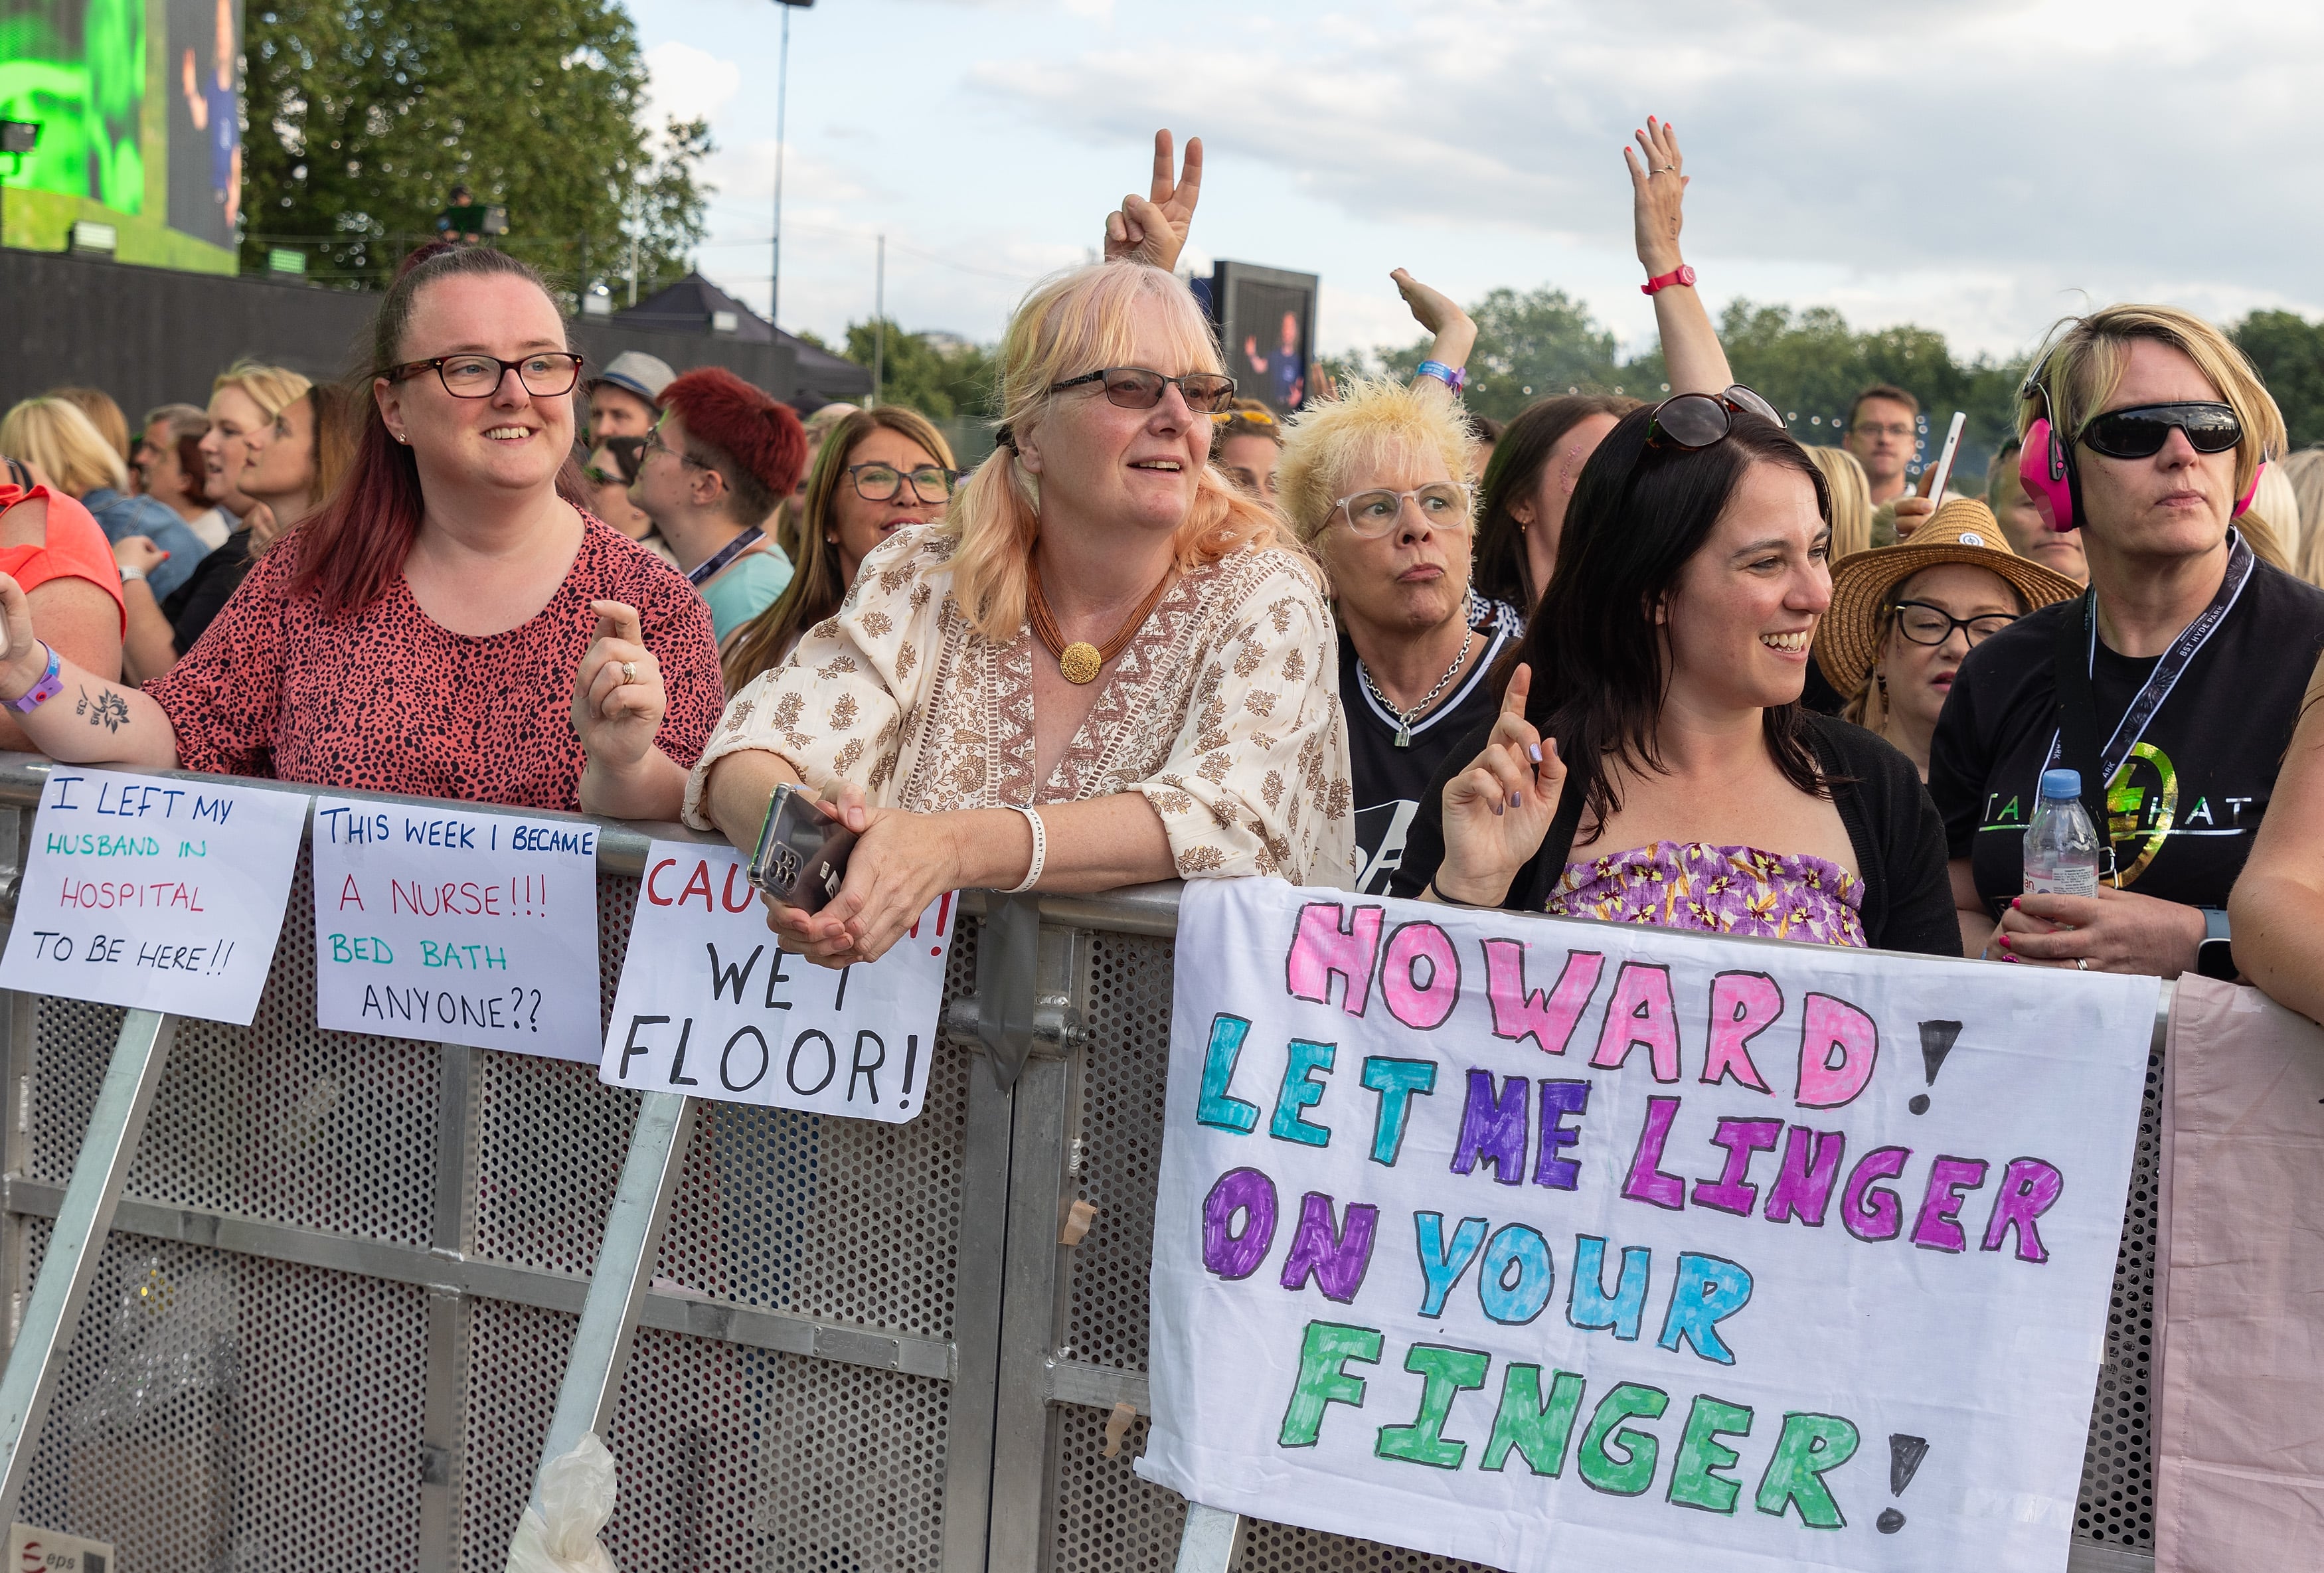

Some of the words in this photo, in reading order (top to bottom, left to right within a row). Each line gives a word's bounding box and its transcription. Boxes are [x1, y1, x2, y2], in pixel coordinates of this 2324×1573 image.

[2179, 641, 2194, 657] BST
[2191, 623, 2210, 643] HYDE
[2206, 605, 2225, 623] PARK
[2053, 740, 2062, 760] ARK
[2102, 761, 2116, 778] ARK
[50, 777, 85, 810] I
[97, 782, 185, 819] LEFT
[193, 795, 234, 825] MY
[46, 832, 159, 857] HUSBAND
[178, 838, 206, 858] IN
[320, 807, 390, 845] THIS
[405, 818, 476, 850] WEEK
[491, 824, 497, 852] I
[512, 826, 594, 856] BECAME
[1030, 811, 1043, 852] GREATEST
[60, 876, 205, 912] HOSPITAL
[339, 872, 365, 912] A
[392, 874, 548, 918] NURSE!!!
[33, 930, 73, 961] TO
[86, 934, 124, 963] BE
[137, 939, 234, 975] HERE!!
[329, 934, 394, 965] BED
[421, 940, 507, 971] BATH
[362, 985, 542, 1033] ANYONE??
[619, 1015, 918, 1110] FLOOR!
[1196, 1012, 1438, 1167] LET
[1450, 1067, 1592, 1192] ME
[1621, 1095, 2064, 1264] LINGER
[1201, 1167, 1379, 1303] ON
[1414, 1210, 1754, 1366] YOUR
[46, 1552, 75, 1570] eps
